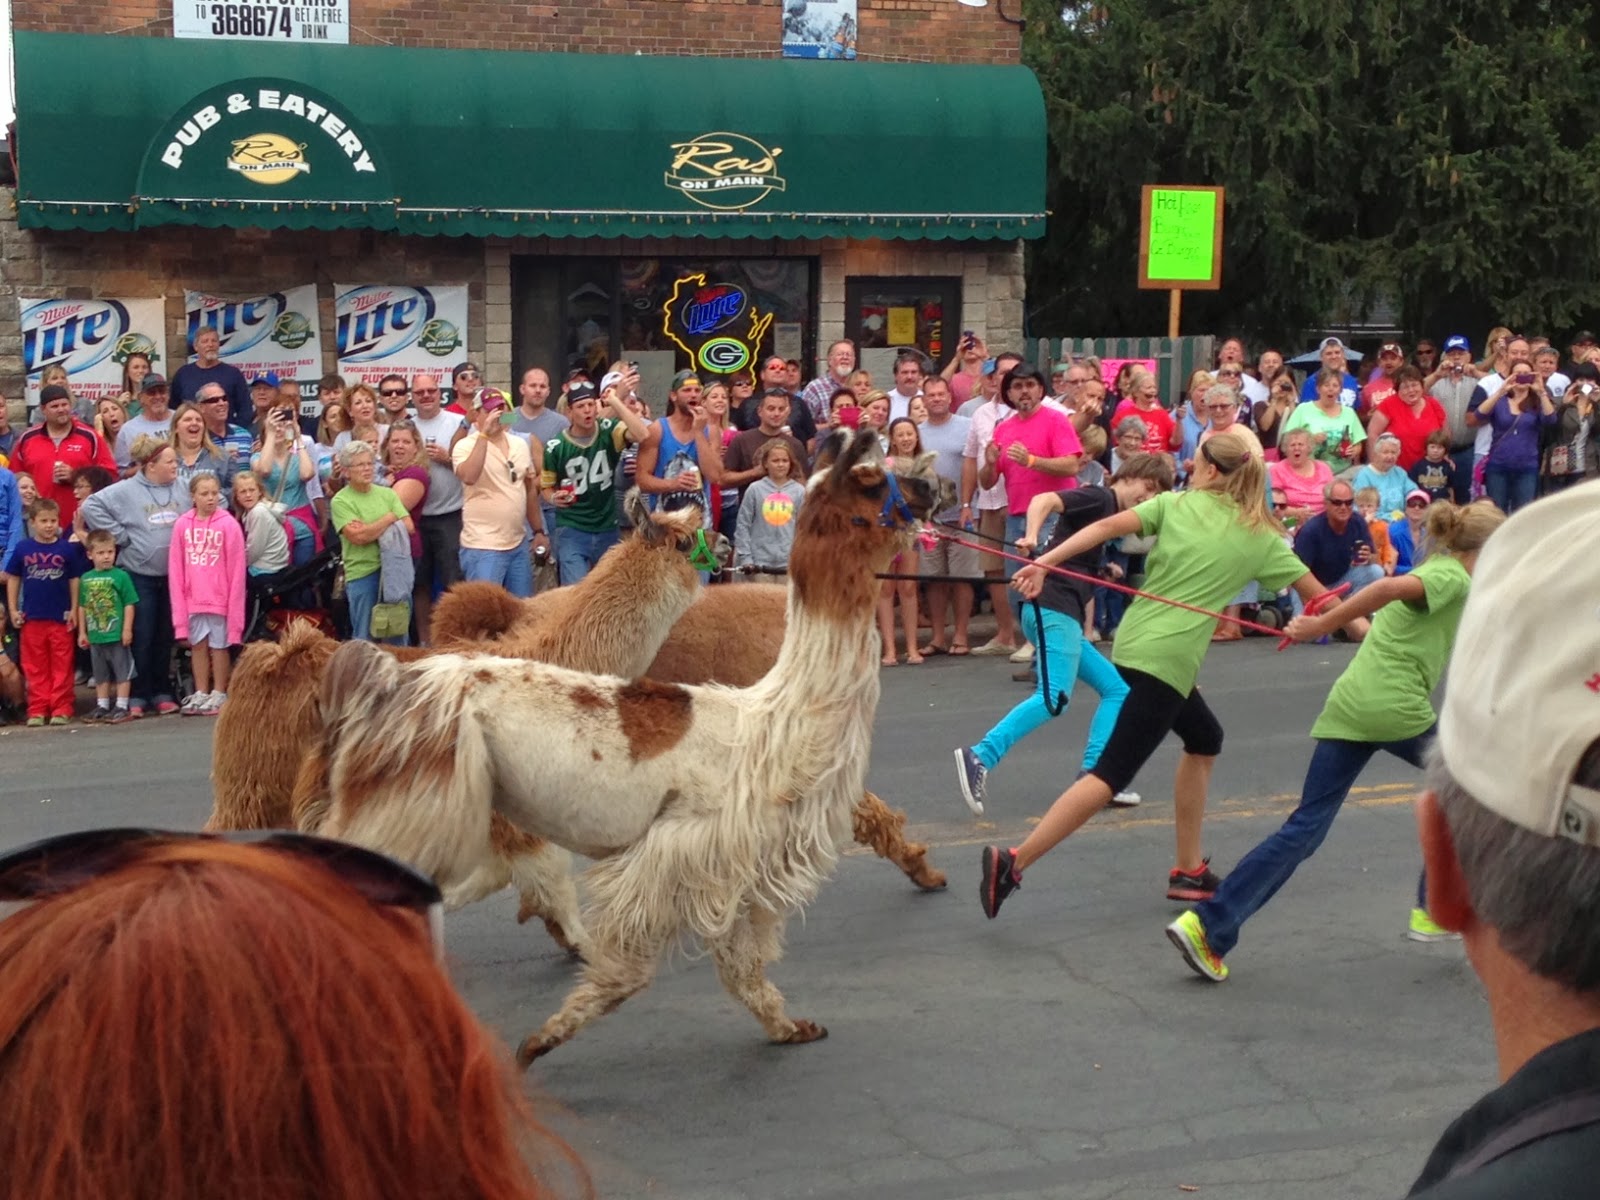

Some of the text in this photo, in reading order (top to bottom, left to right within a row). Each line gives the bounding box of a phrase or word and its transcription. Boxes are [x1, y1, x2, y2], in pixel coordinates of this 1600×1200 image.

[195, 4, 207, 19] TO
[211, 4, 292, 38] 368674
[294, 8, 310, 23] GET
[314, 9, 320, 22] A
[321, 9, 342, 24] FREE
[302, 25, 328, 39] DRINK
[161, 89, 376, 173] PUB & EATERY
[262, 162, 295, 170] MAIN
[680, 176, 764, 189] ON MAIN
[351, 291, 394, 311] Miller
[35, 304, 84, 326] Miller
[688, 292, 742, 334] Lite
[337, 296, 418, 359] Lite
[23, 309, 111, 374] Lite
[302, 406, 316, 414] EAT
[565, 449, 613, 495] 94
[184, 527, 223, 547] AERO
[24, 552, 65, 567] NYC
[185, 552, 219, 566] 1987
